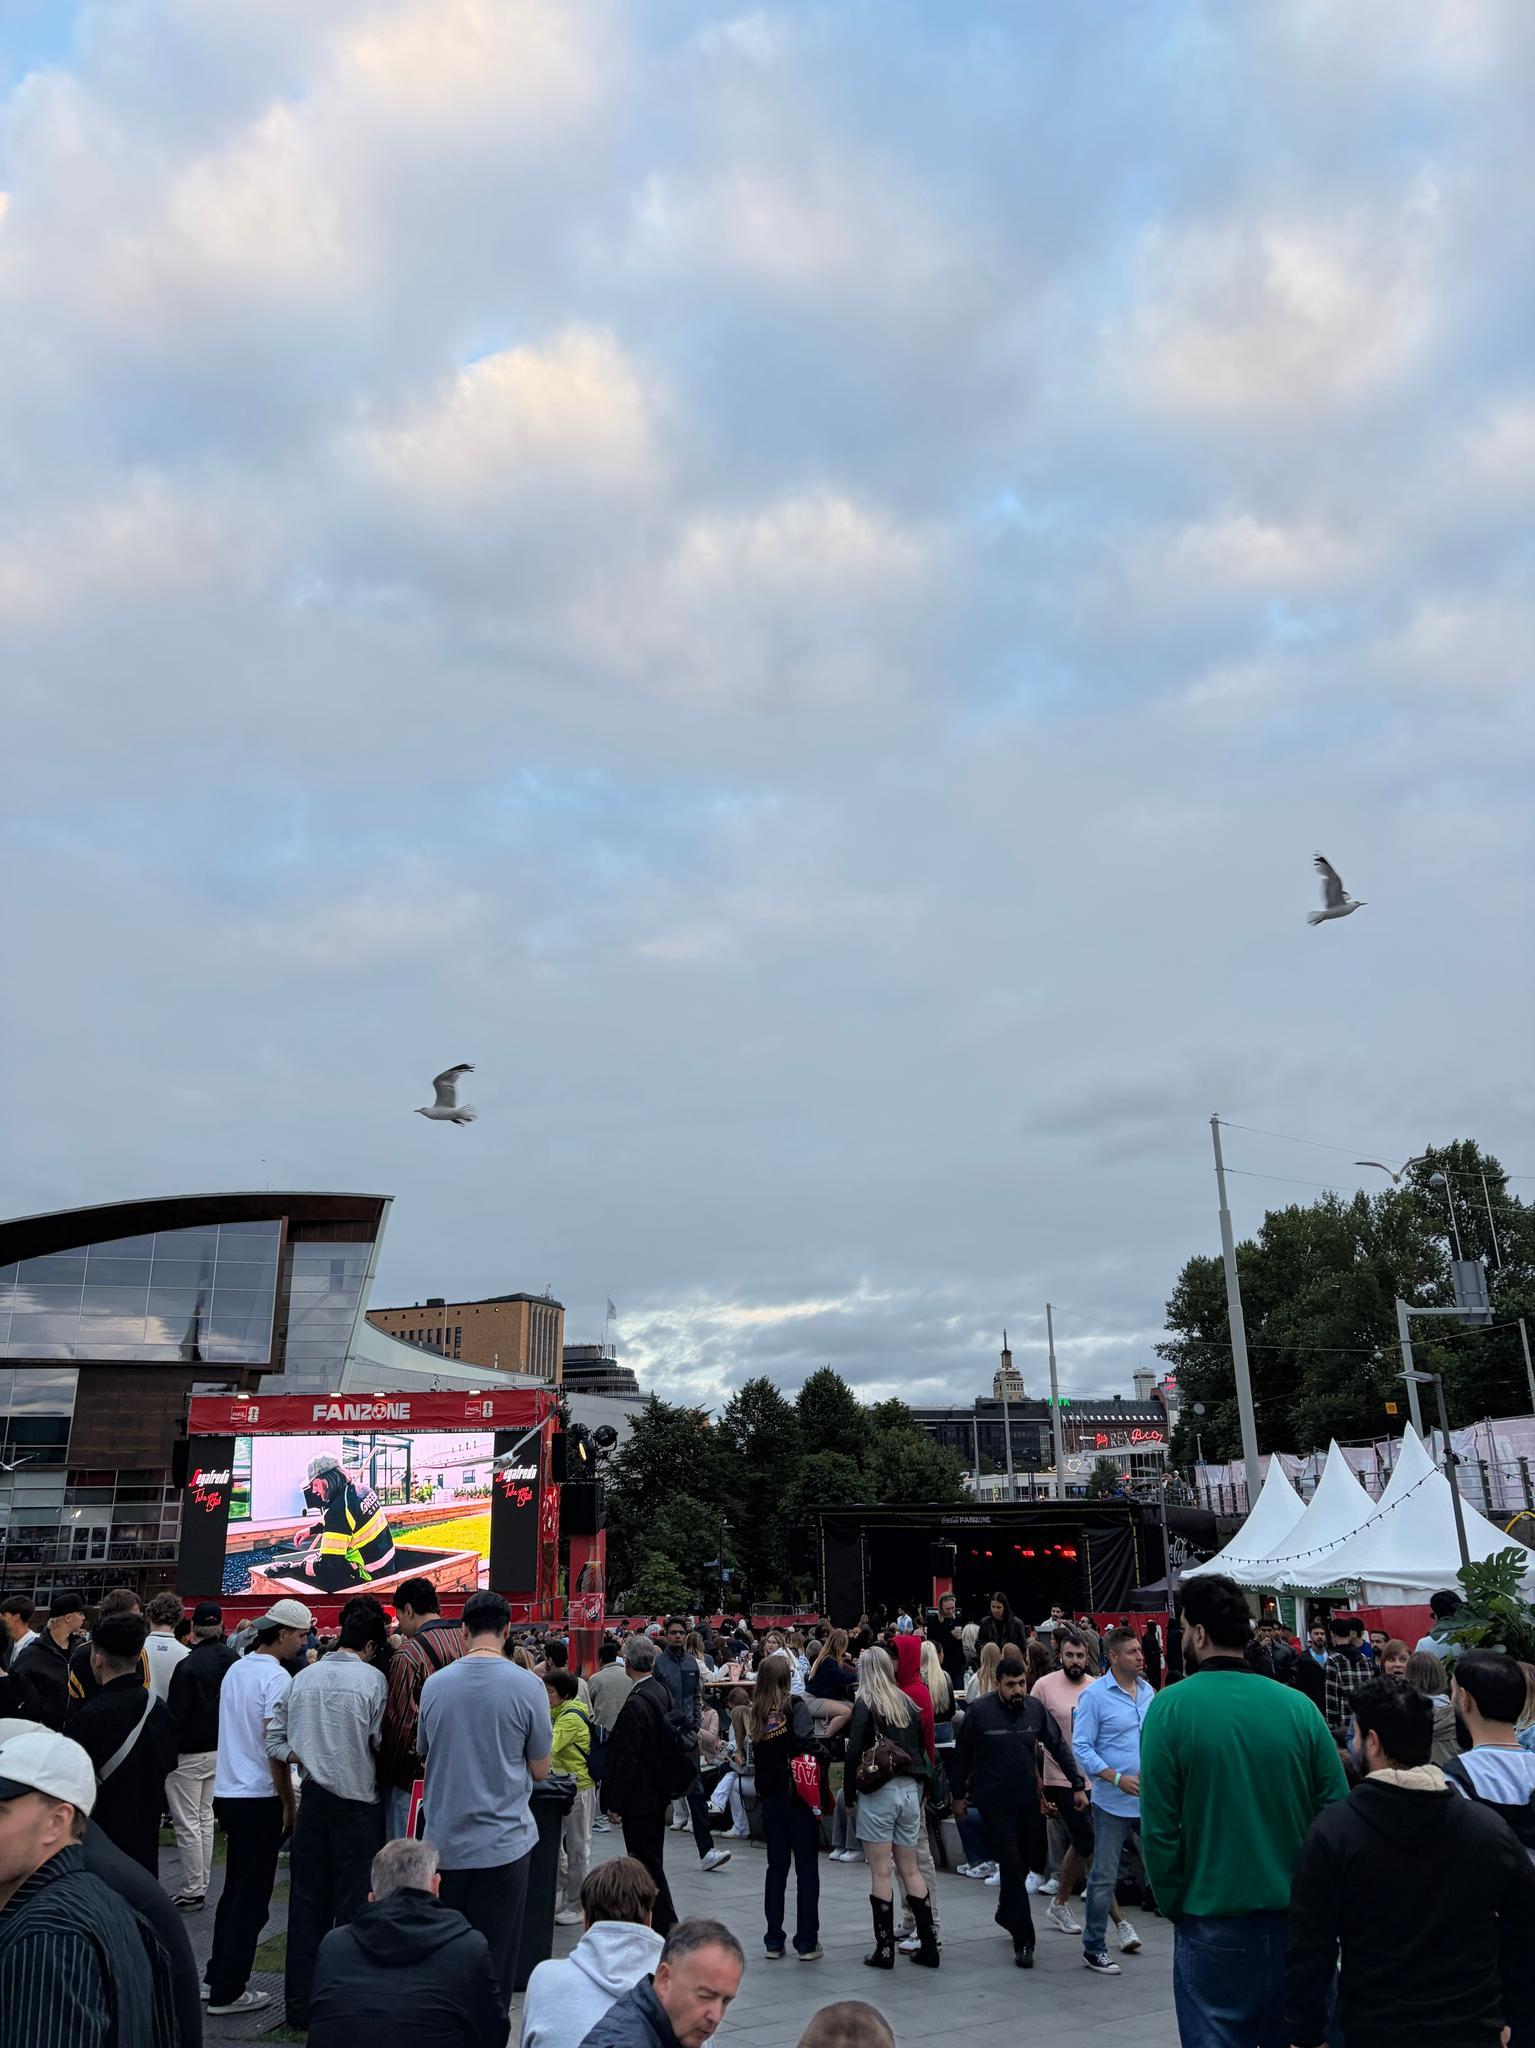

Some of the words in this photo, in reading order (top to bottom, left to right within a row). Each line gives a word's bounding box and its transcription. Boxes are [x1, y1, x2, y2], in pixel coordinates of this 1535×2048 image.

[312, 1402, 411, 1422] FANZONE
[1109, 1431, 1133, 1447] REX
[188, 1469, 230, 1487] Segafredo
